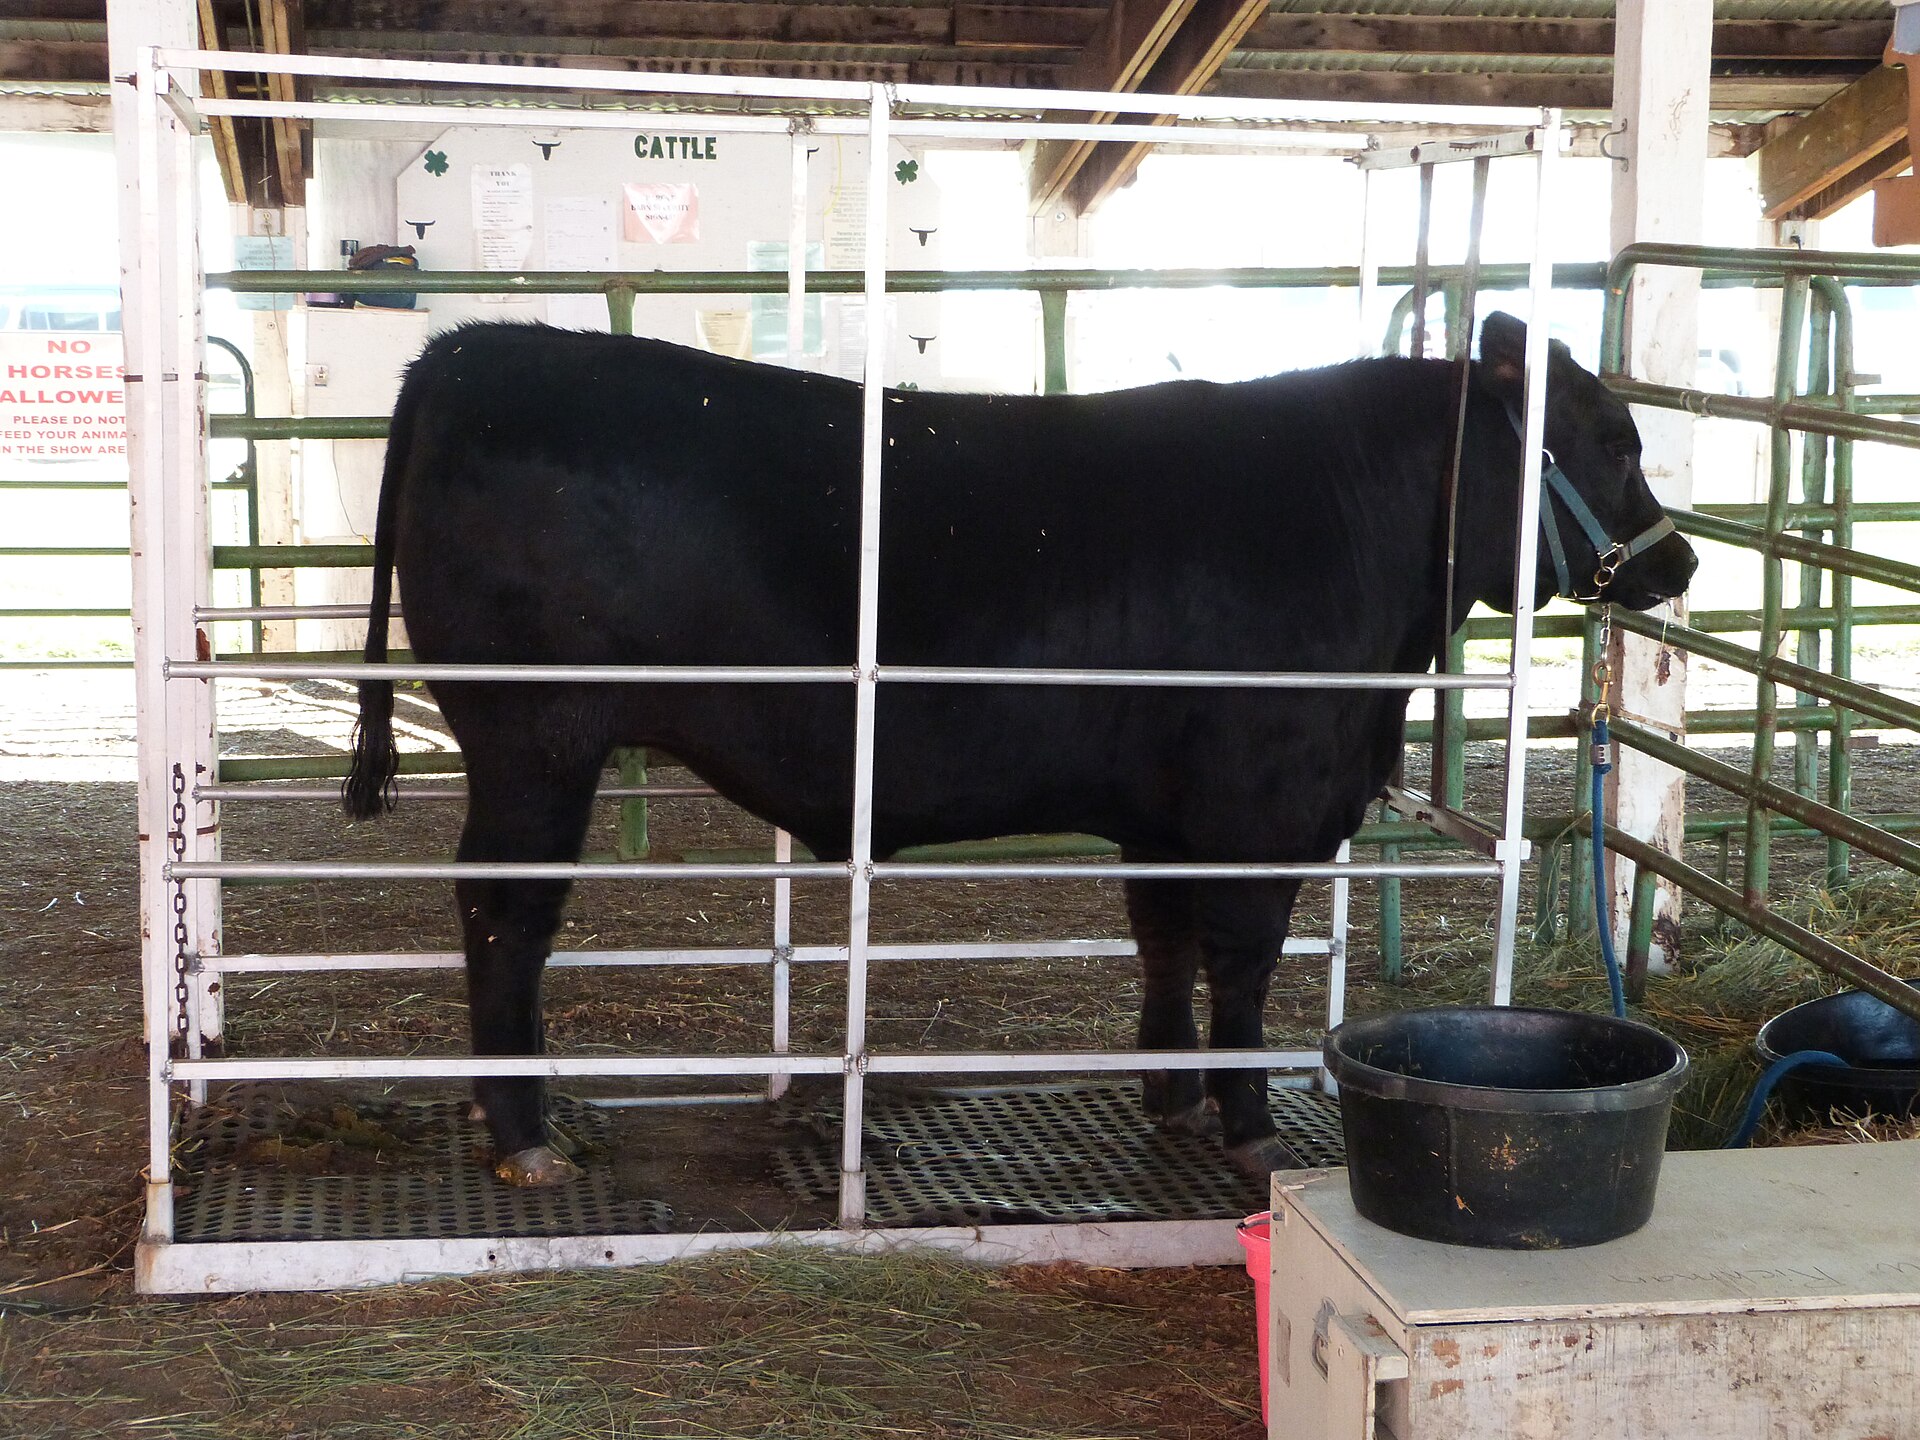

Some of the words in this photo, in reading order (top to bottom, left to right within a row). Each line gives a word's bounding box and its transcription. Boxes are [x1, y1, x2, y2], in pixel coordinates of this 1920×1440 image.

[634, 134, 717, 160] CATTLE
[47, 340, 91, 353] NO
[13, 416, 68, 424] PLEASE
[73, 416, 93, 424] DO
[98, 416, 126, 424] NOT
